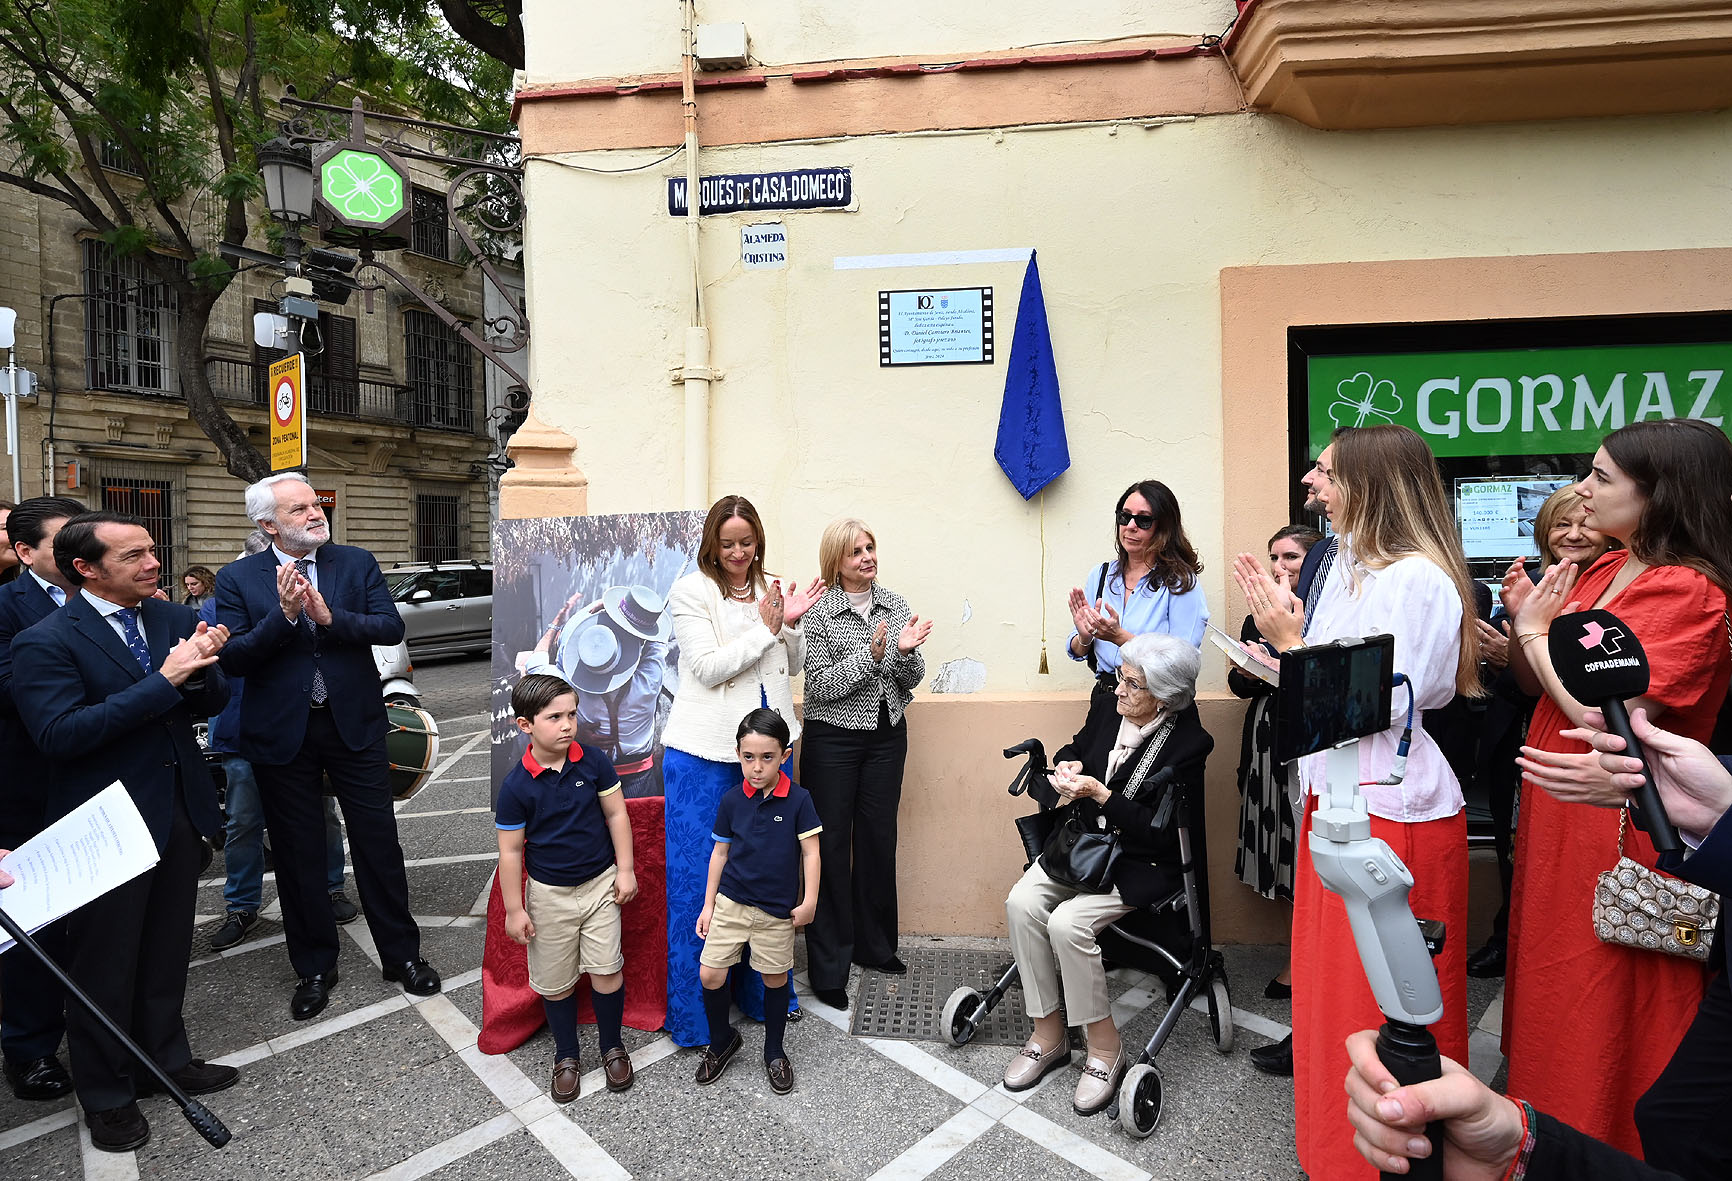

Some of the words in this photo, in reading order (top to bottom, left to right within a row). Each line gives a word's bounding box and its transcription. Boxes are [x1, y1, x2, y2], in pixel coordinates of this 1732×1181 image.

[674, 178, 734, 208] MQUÉS
[753, 172, 844, 204] CASA-DOMECQ
[744, 232, 785, 244] ALAMEDA
[744, 252, 785, 264] CRISTINA
[1416, 369, 1725, 439] GORMAZ
[1473, 484, 1512, 494] GORMAZ
[317, 494, 334, 503] ter.
[1584, 656, 1640, 672] COFRADEMANÍA
